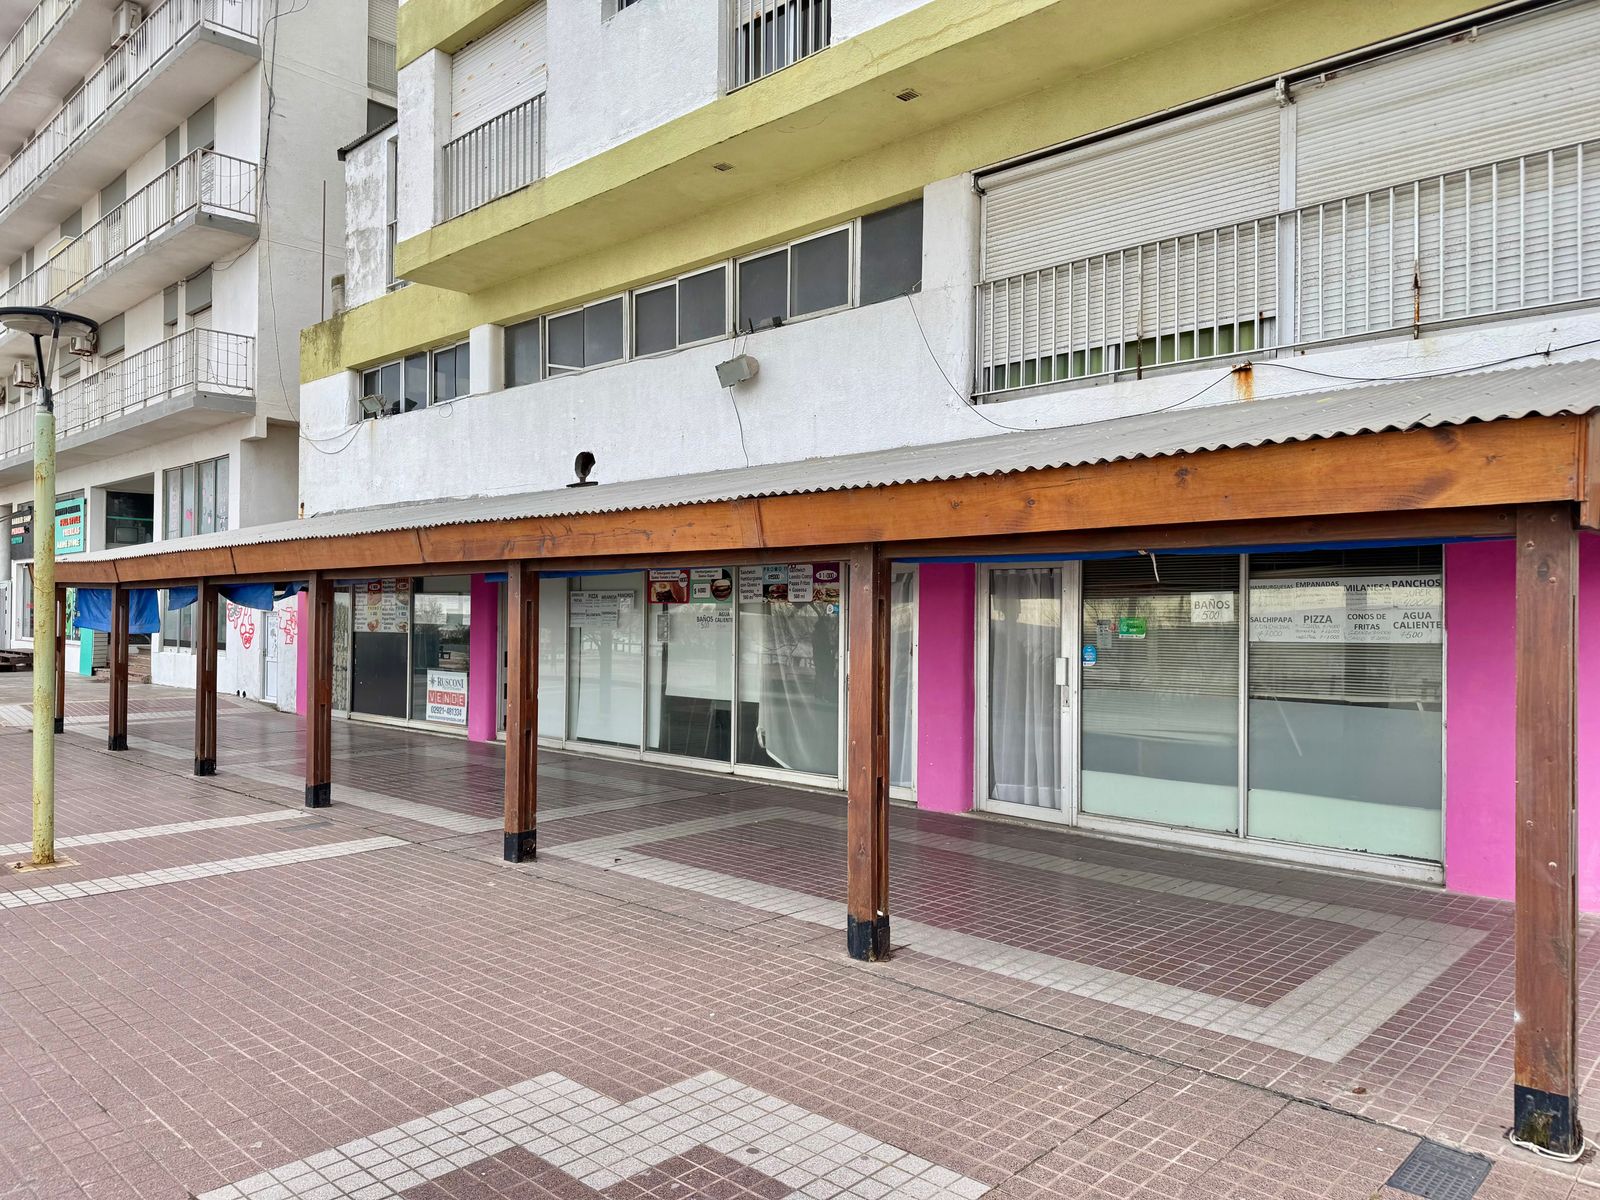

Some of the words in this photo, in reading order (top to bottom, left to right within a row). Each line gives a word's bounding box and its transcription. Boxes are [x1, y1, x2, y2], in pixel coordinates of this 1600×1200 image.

[1295, 580, 1340, 588] EMPANADAS
[1343, 583, 1391, 592] MILANESA
[1391, 578, 1441, 588] PANCHOS
[1194, 598, 1231, 610] BAÑOS
[696, 614, 714, 623] BAÑOS
[1202, 610, 1220, 620] 500
[1303, 614, 1333, 624] PIZZA
[1402, 611, 1432, 620] AGUA
[1393, 621, 1441, 630] CALIENTE
[437, 676, 464, 689] RUSCONI
[429, 691, 464, 706] VENDE
